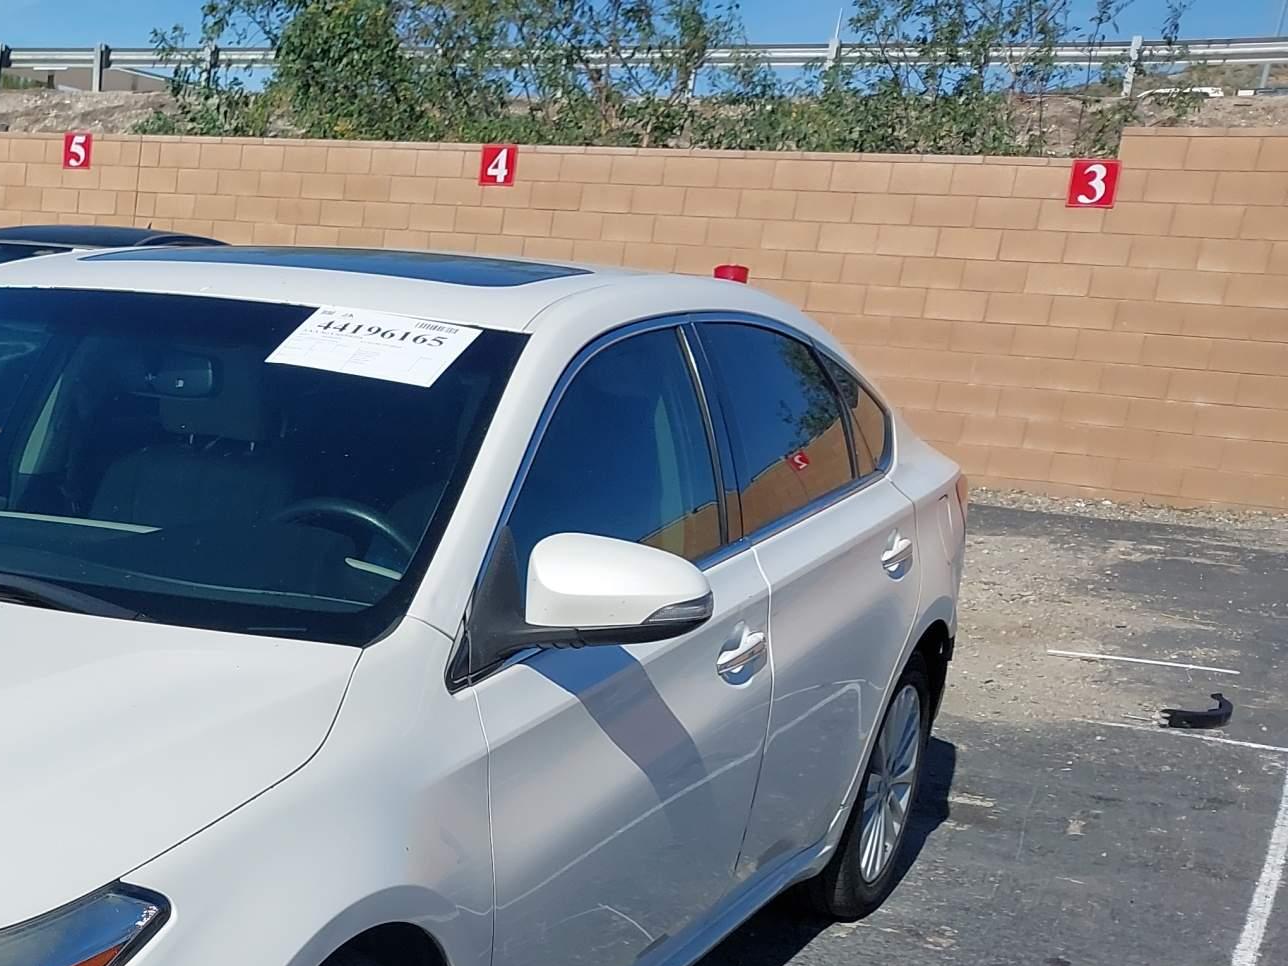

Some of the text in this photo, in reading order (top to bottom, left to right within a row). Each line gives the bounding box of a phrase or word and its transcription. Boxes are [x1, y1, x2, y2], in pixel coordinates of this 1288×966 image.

[69, 135, 86, 167] 5
[487, 148, 508, 183] 4
[1077, 164, 1107, 204] 3
[316, 319, 449, 348] 44196165
